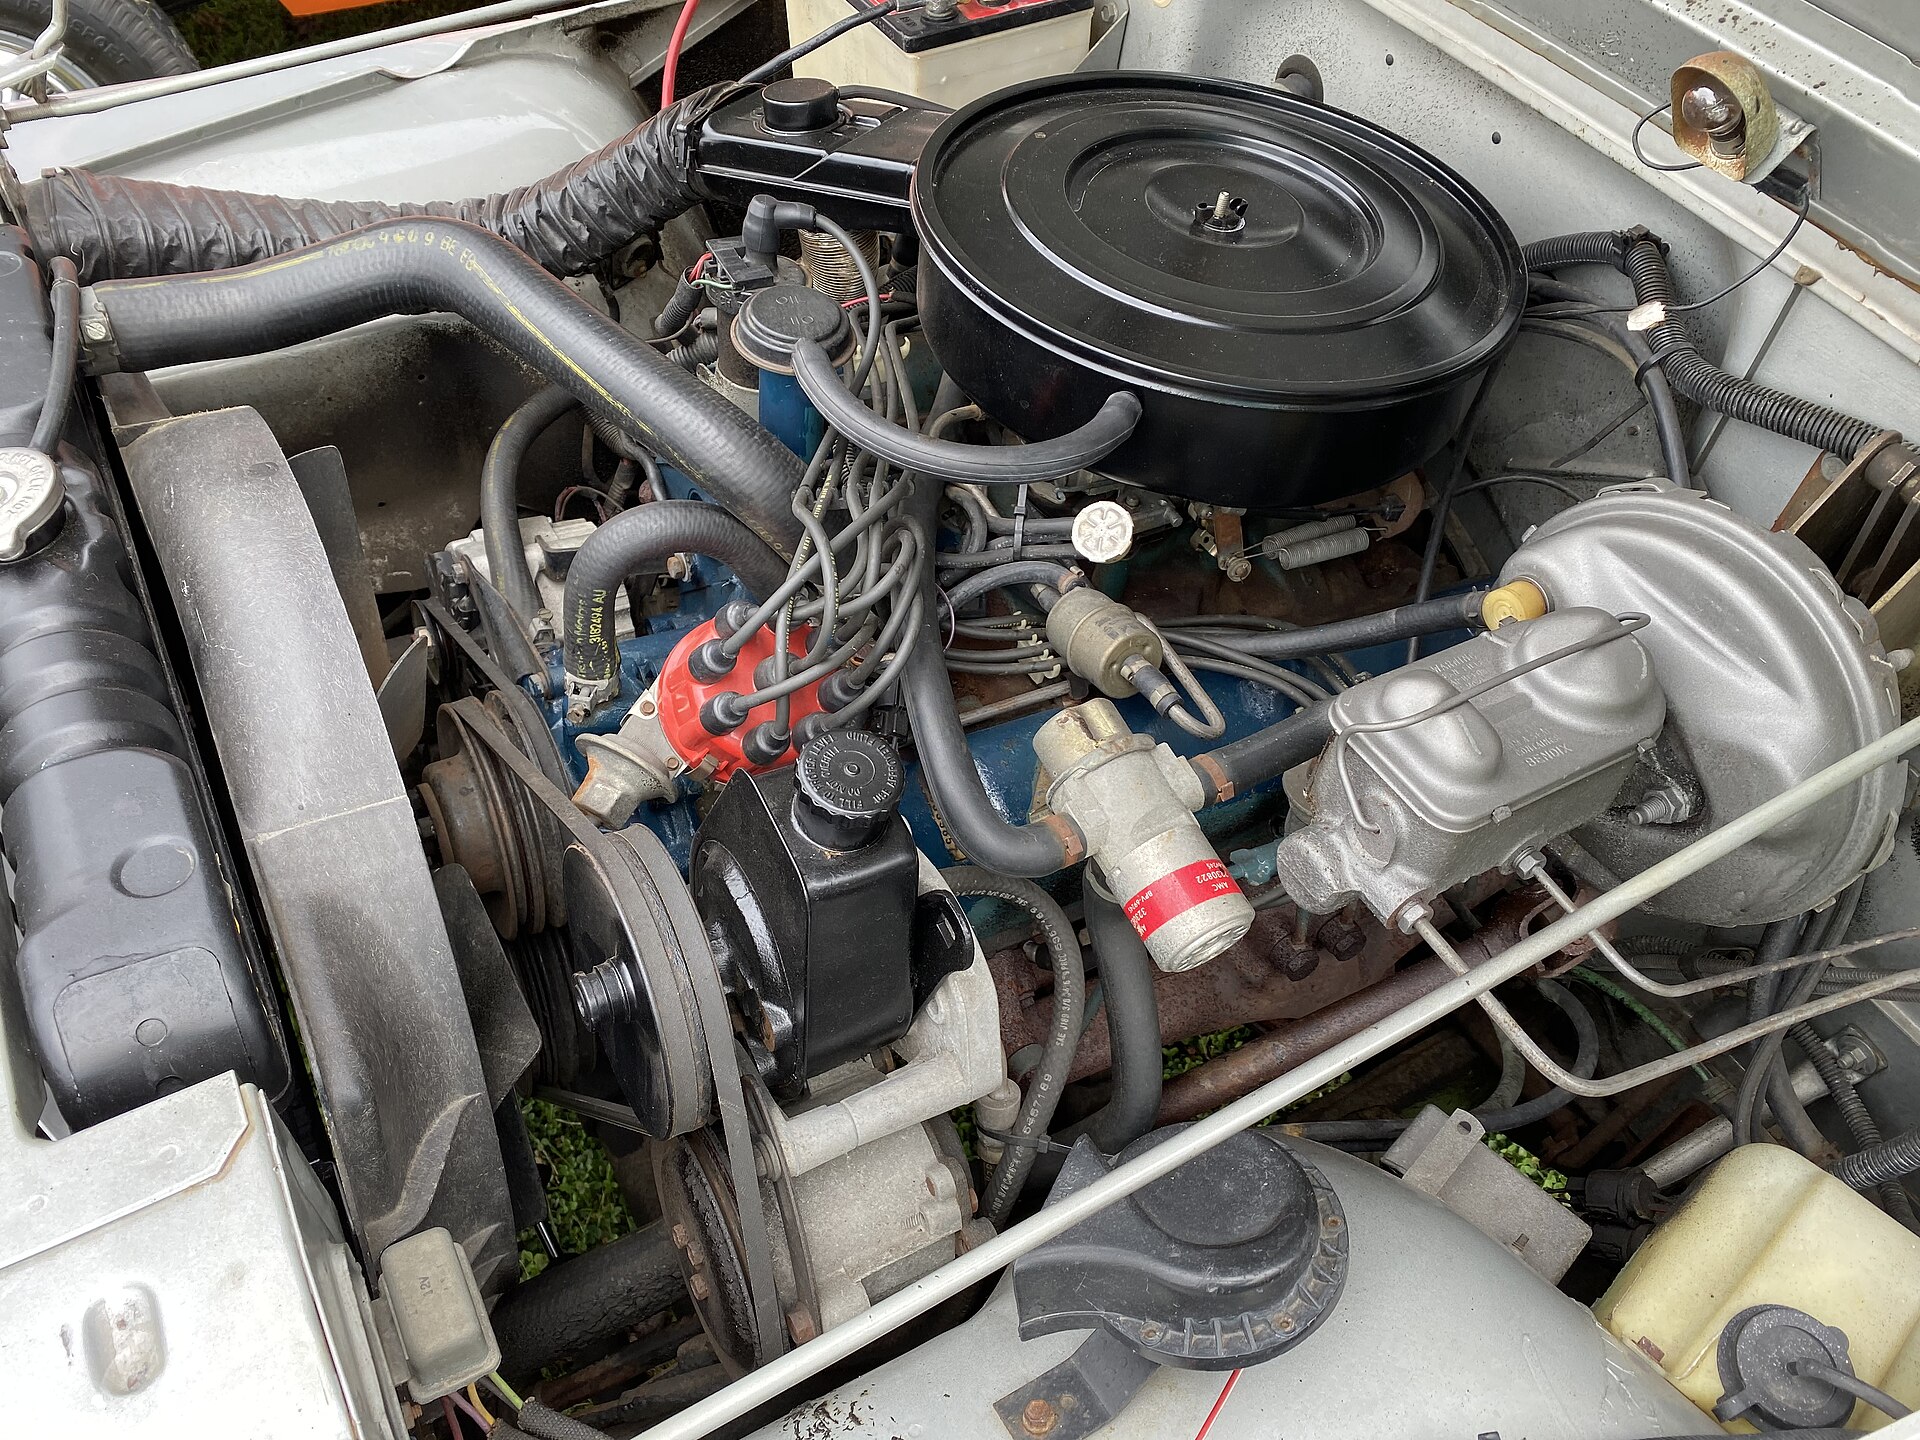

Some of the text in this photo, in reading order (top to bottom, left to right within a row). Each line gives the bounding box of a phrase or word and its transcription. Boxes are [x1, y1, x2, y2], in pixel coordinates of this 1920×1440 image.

[809, 734, 835, 756] LEVEL
[846, 731, 876, 746] FLUID
[1525, 743, 1574, 767] BENDIX
[805, 758, 824, 792] PROPER
[839, 797, 864, 810] FILL
[1211, 881, 1230, 892] AMC
[1055, 1032, 1067, 1047] SAE
